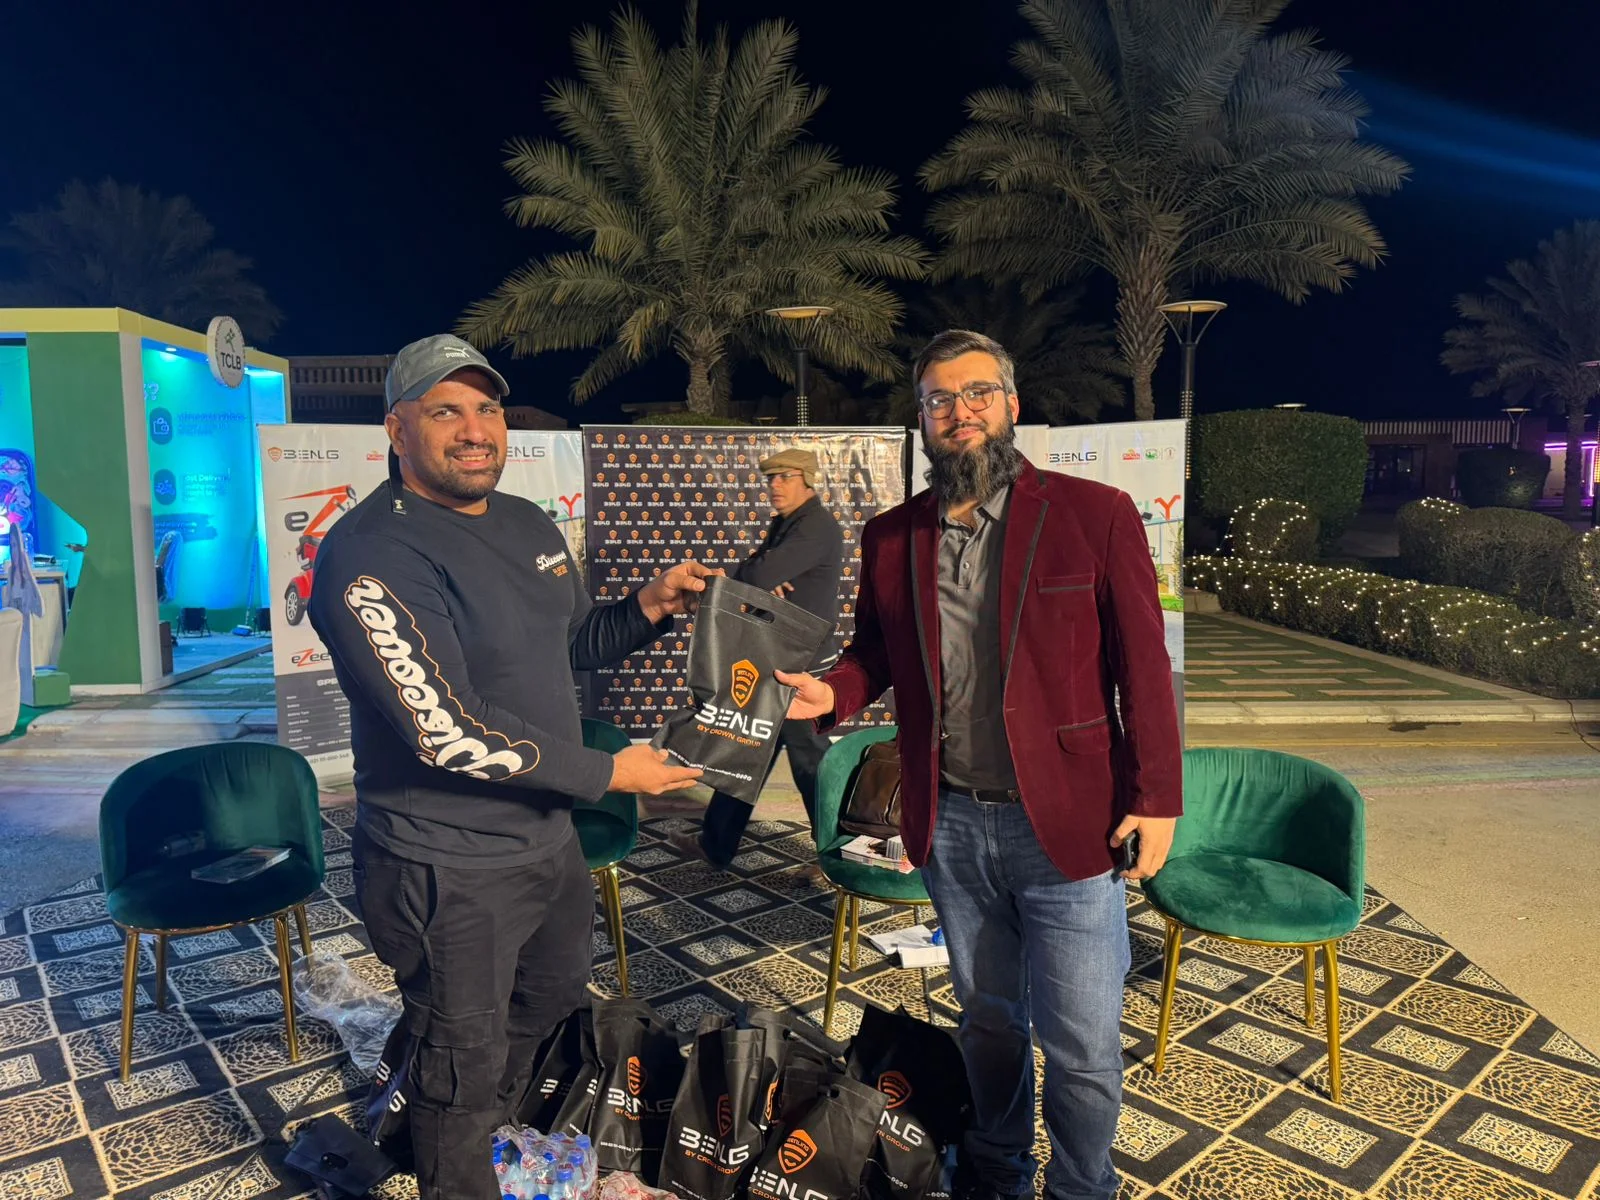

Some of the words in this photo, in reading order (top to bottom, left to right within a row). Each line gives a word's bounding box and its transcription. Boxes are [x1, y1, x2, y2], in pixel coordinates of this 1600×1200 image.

[220, 352, 242, 370] TCLB
[347, 578, 523, 780] Discover
[736, 736, 761, 747] GROUP
